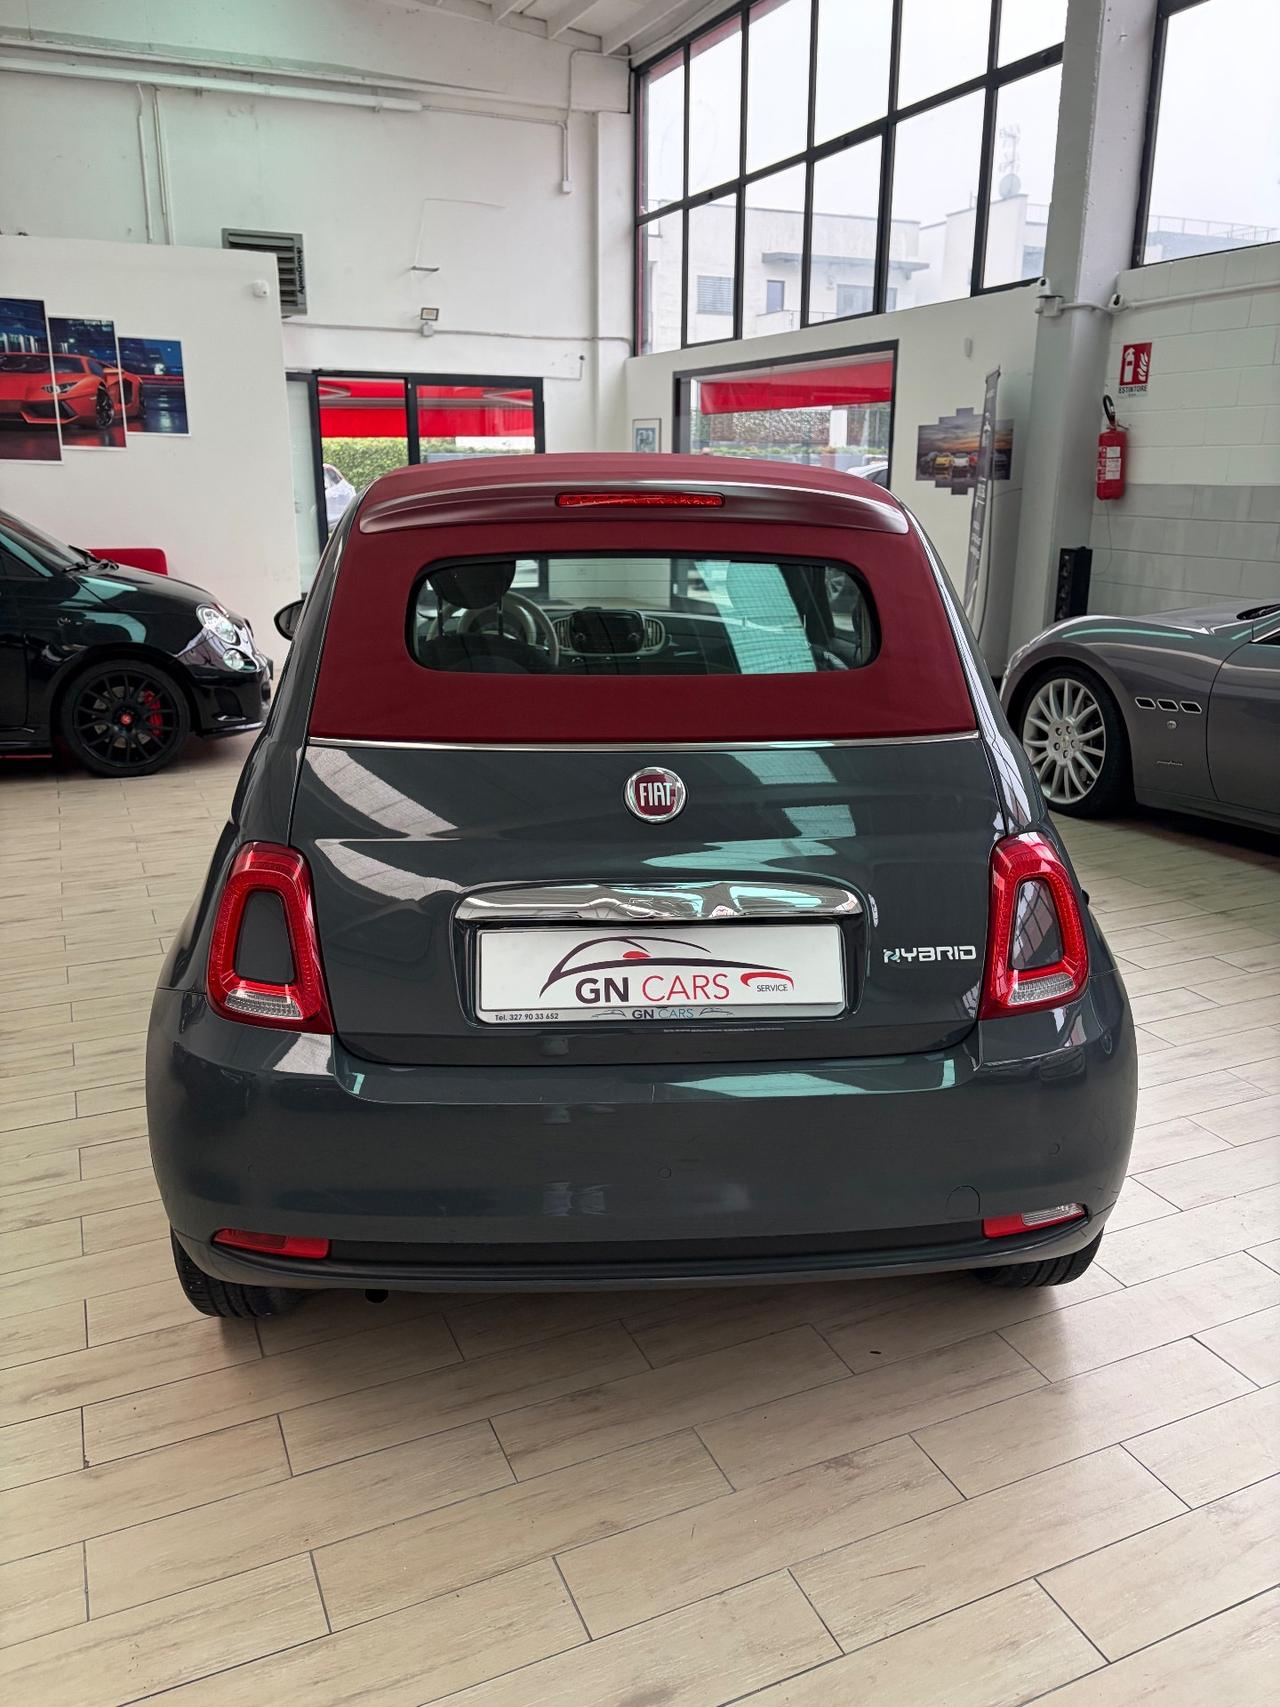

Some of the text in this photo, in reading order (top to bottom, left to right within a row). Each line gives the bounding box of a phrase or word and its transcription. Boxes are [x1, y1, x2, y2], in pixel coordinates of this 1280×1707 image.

[1118, 385, 1148, 394] ESTINTORE
[639, 782, 672, 806] FIAT
[883, 945, 977, 963] HYBRID
[575, 973, 730, 1004] GN CARS
[756, 983, 789, 993] SERVICE
[546, 1012, 559, 1020] 652
[631, 1008, 694, 1019] GN CARS
